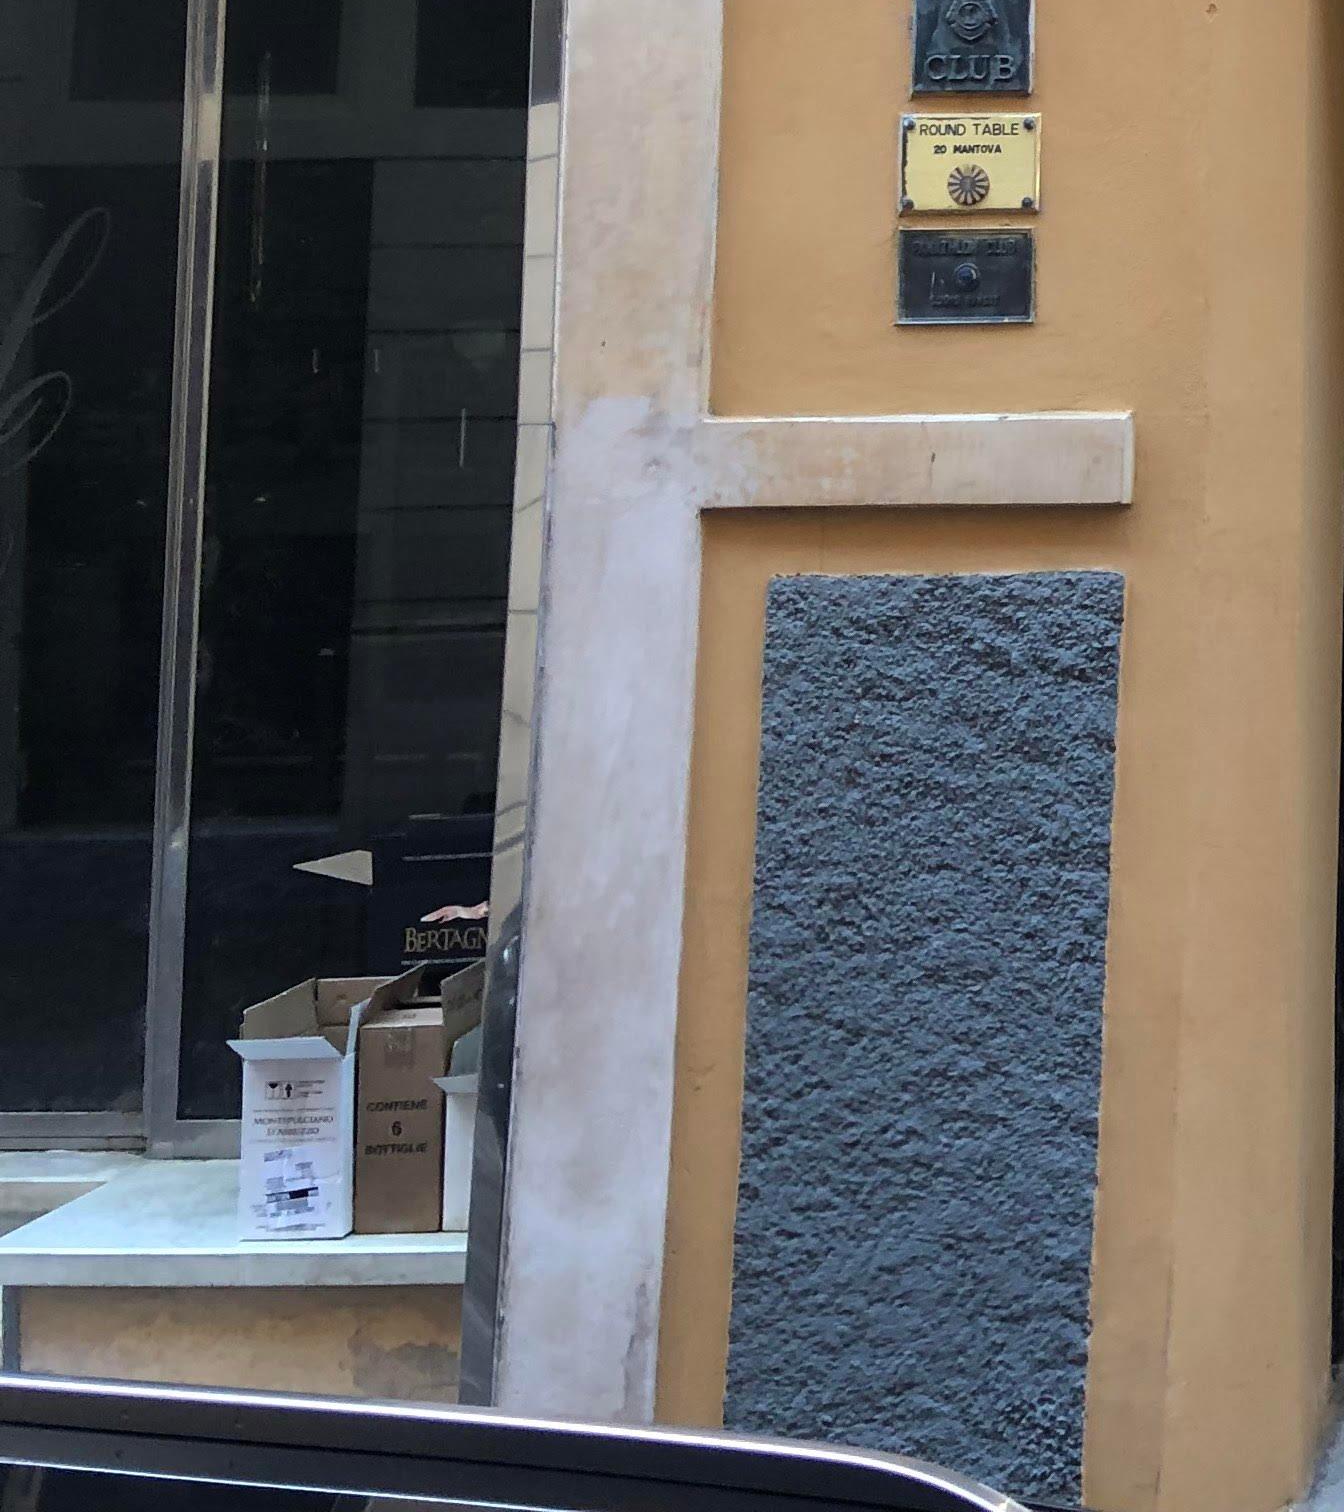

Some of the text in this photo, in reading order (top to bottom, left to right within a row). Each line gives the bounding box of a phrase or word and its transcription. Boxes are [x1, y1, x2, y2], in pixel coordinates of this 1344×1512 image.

[924, 54, 1016, 83] CLUB
[919, 122, 1020, 136] ROUND TABLE
[933, 143, 1003, 155] 20 MANTOVA
[366, 1098, 428, 1113] CONTIENE
[391, 1120, 402, 1138] 6
